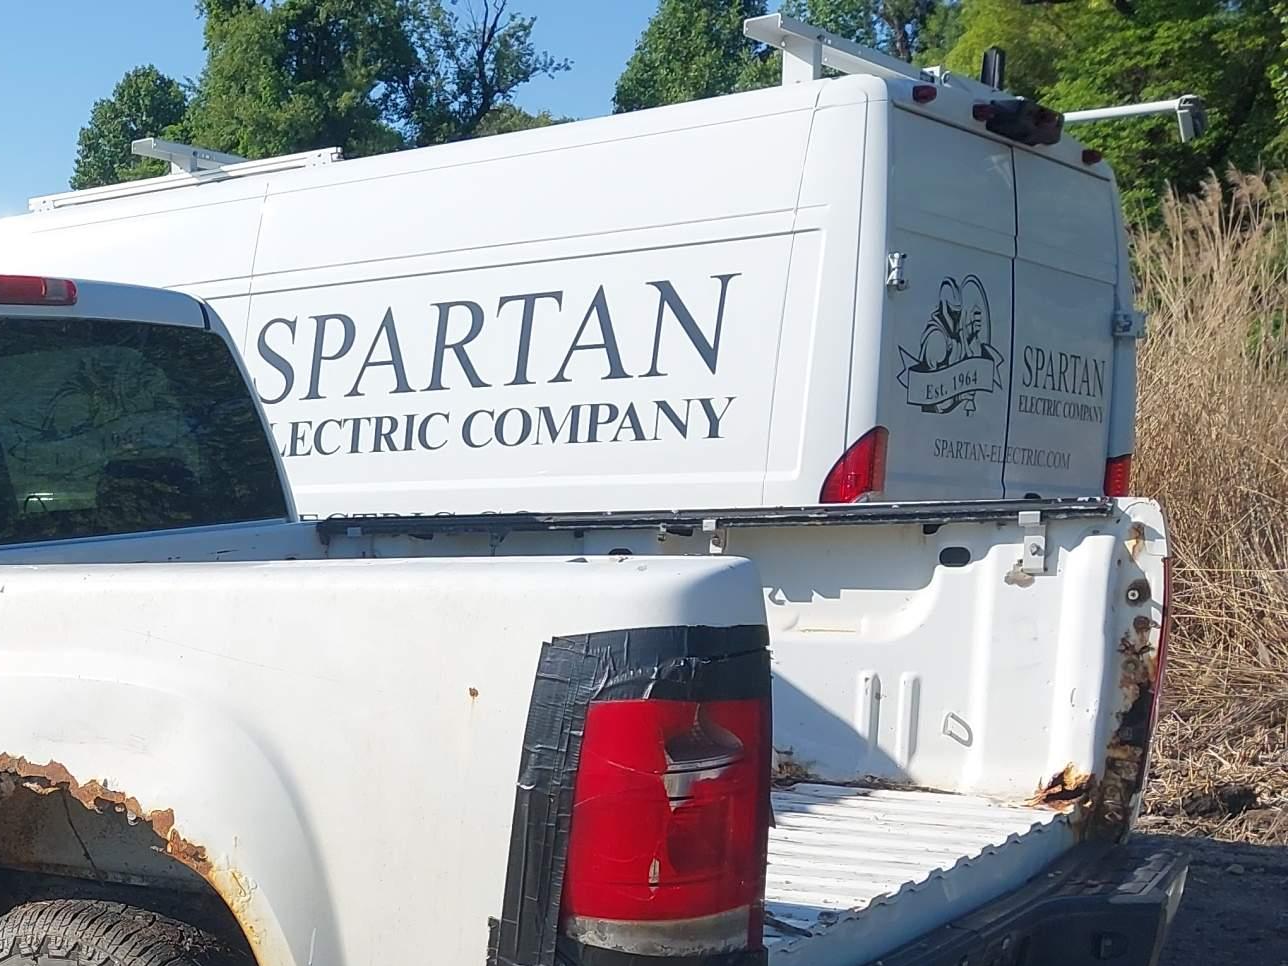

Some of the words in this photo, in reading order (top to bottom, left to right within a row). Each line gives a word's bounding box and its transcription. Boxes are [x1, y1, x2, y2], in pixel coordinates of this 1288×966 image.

[253, 272, 743, 405] SPARTAN
[926, 383, 948, 400] Est.
[953, 369, 978, 391] 1964
[1022, 345, 1106, 398] SPARTAN
[269, 411, 451, 458] LECTRIC
[461, 397, 738, 449] COMPANY
[1018, 394, 1062, 417] ELECTRIC
[1062, 401, 1104, 424] COMPANY
